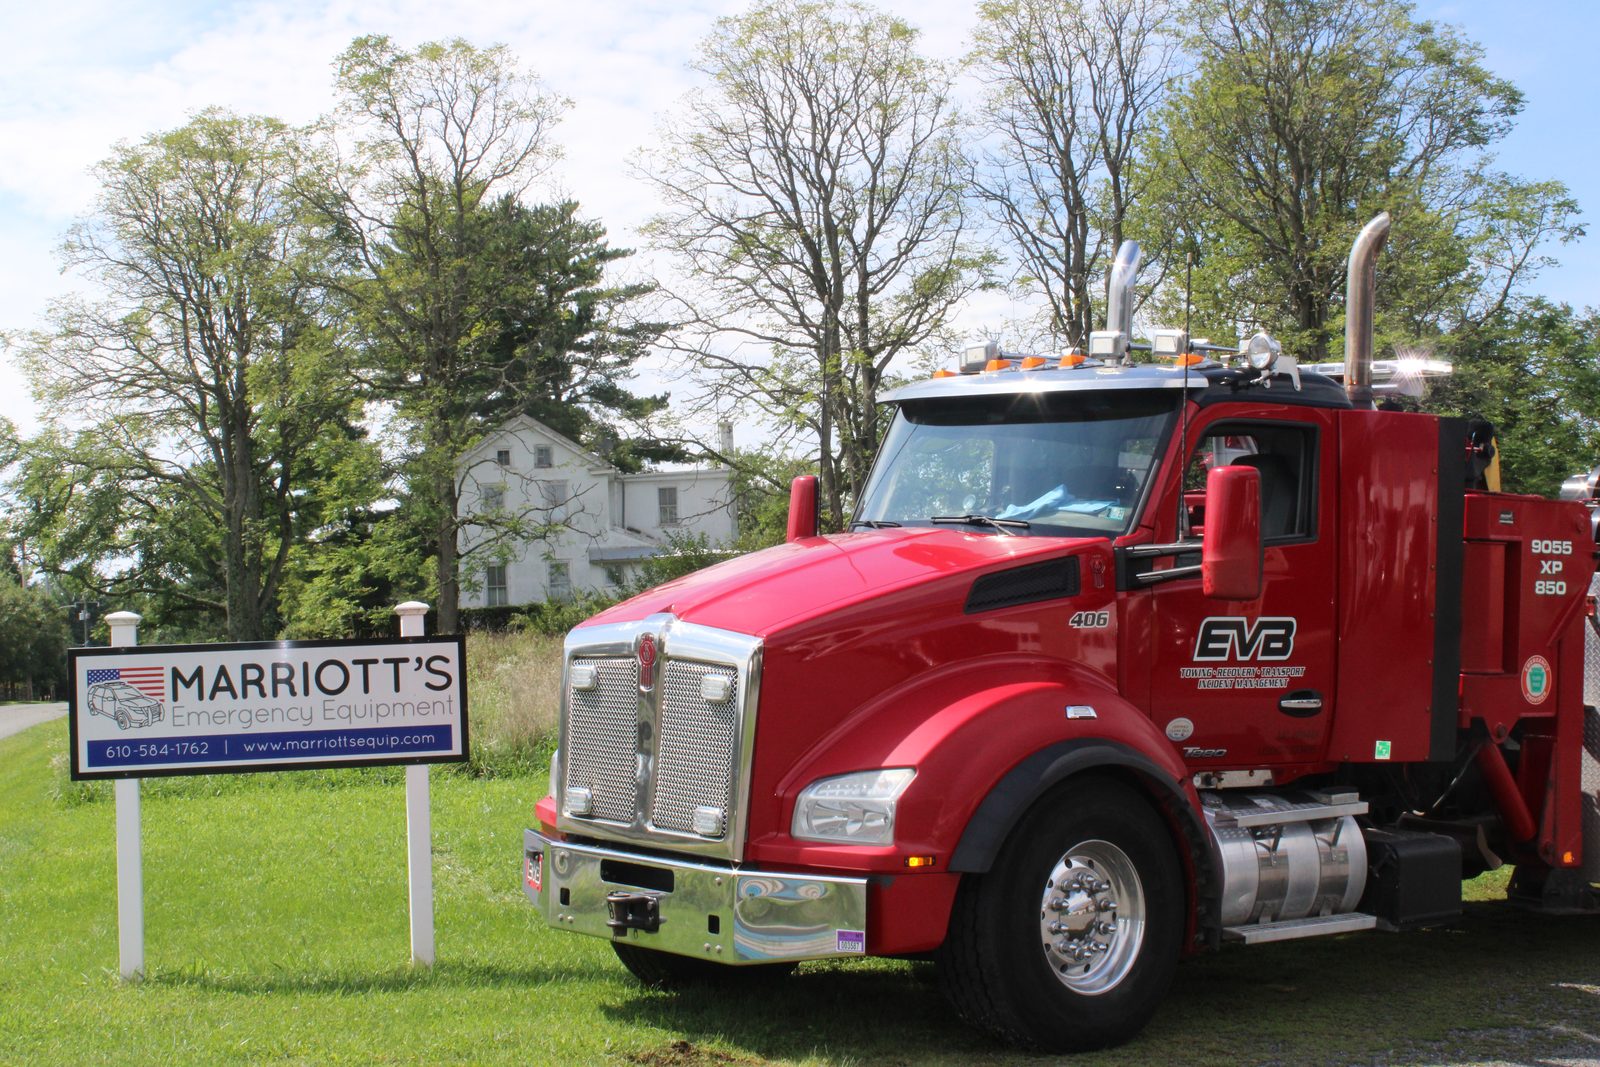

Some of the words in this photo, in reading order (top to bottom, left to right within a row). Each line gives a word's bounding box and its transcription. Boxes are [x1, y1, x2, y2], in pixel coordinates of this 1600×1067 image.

[1531, 539, 1573, 555] 9055
[1540, 560, 1563, 574] XP
[1535, 581, 1567, 595] 850
[1068, 610, 1110, 629] 406
[1193, 616, 1297, 662] EVB
[171, 655, 453, 703] MARRIOTT'S
[1180, 668, 1213, 678] TOWING
[1216, 667, 1258, 678] RECOVERY
[1261, 667, 1306, 677] TRANSPORT
[1197, 679, 1235, 689] INCIDENT
[1235, 678, 1290, 688] MANAGEMENT
[172, 705, 313, 729] Emergency
[322, 695, 453, 725] Equipment
[106, 742, 209, 759] 610-584-1762
[244, 733, 435, 752] www.marriottsequip.com
